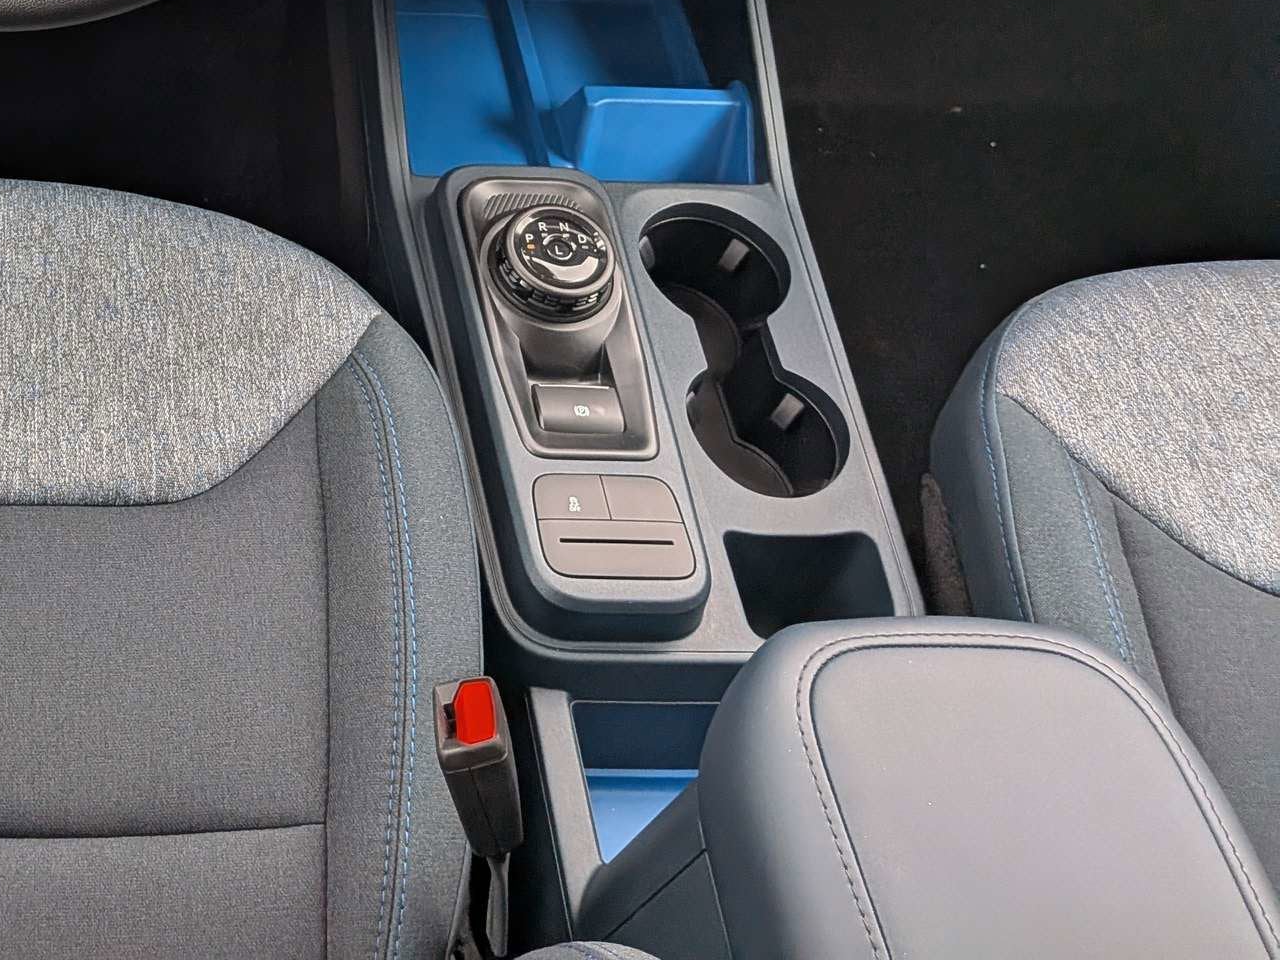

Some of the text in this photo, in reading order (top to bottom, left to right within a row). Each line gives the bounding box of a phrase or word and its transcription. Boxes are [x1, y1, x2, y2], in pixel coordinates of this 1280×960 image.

[538, 222, 548, 231] R
[559, 222, 569, 231] N
[525, 234, 534, 243] P
[577, 233, 587, 243] D
[555, 245, 564, 255] L
